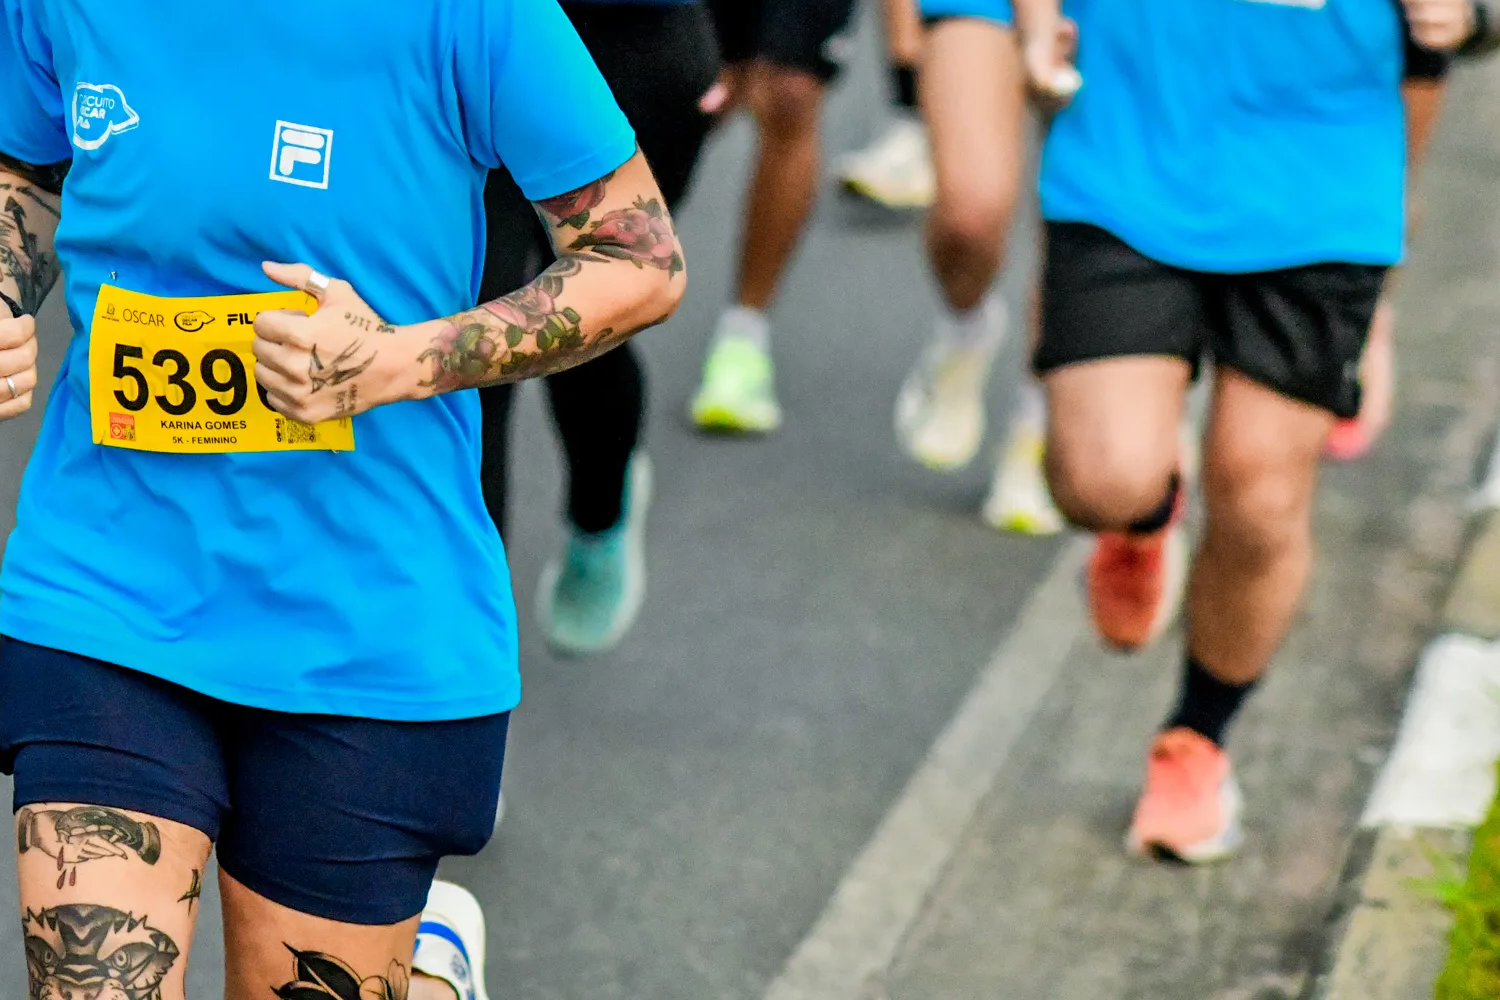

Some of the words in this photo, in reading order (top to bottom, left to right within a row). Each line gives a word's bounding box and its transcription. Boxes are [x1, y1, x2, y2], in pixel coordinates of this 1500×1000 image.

[122, 308, 165, 327] OSCAR
[227, 312, 260, 326] FIL
[112, 343, 279, 416] 539
[160, 420, 203, 430] KARINA
[205, 420, 247, 430] GOMES
[172, 436, 184, 444] 5K
[191, 436, 238, 445] FEMININO
